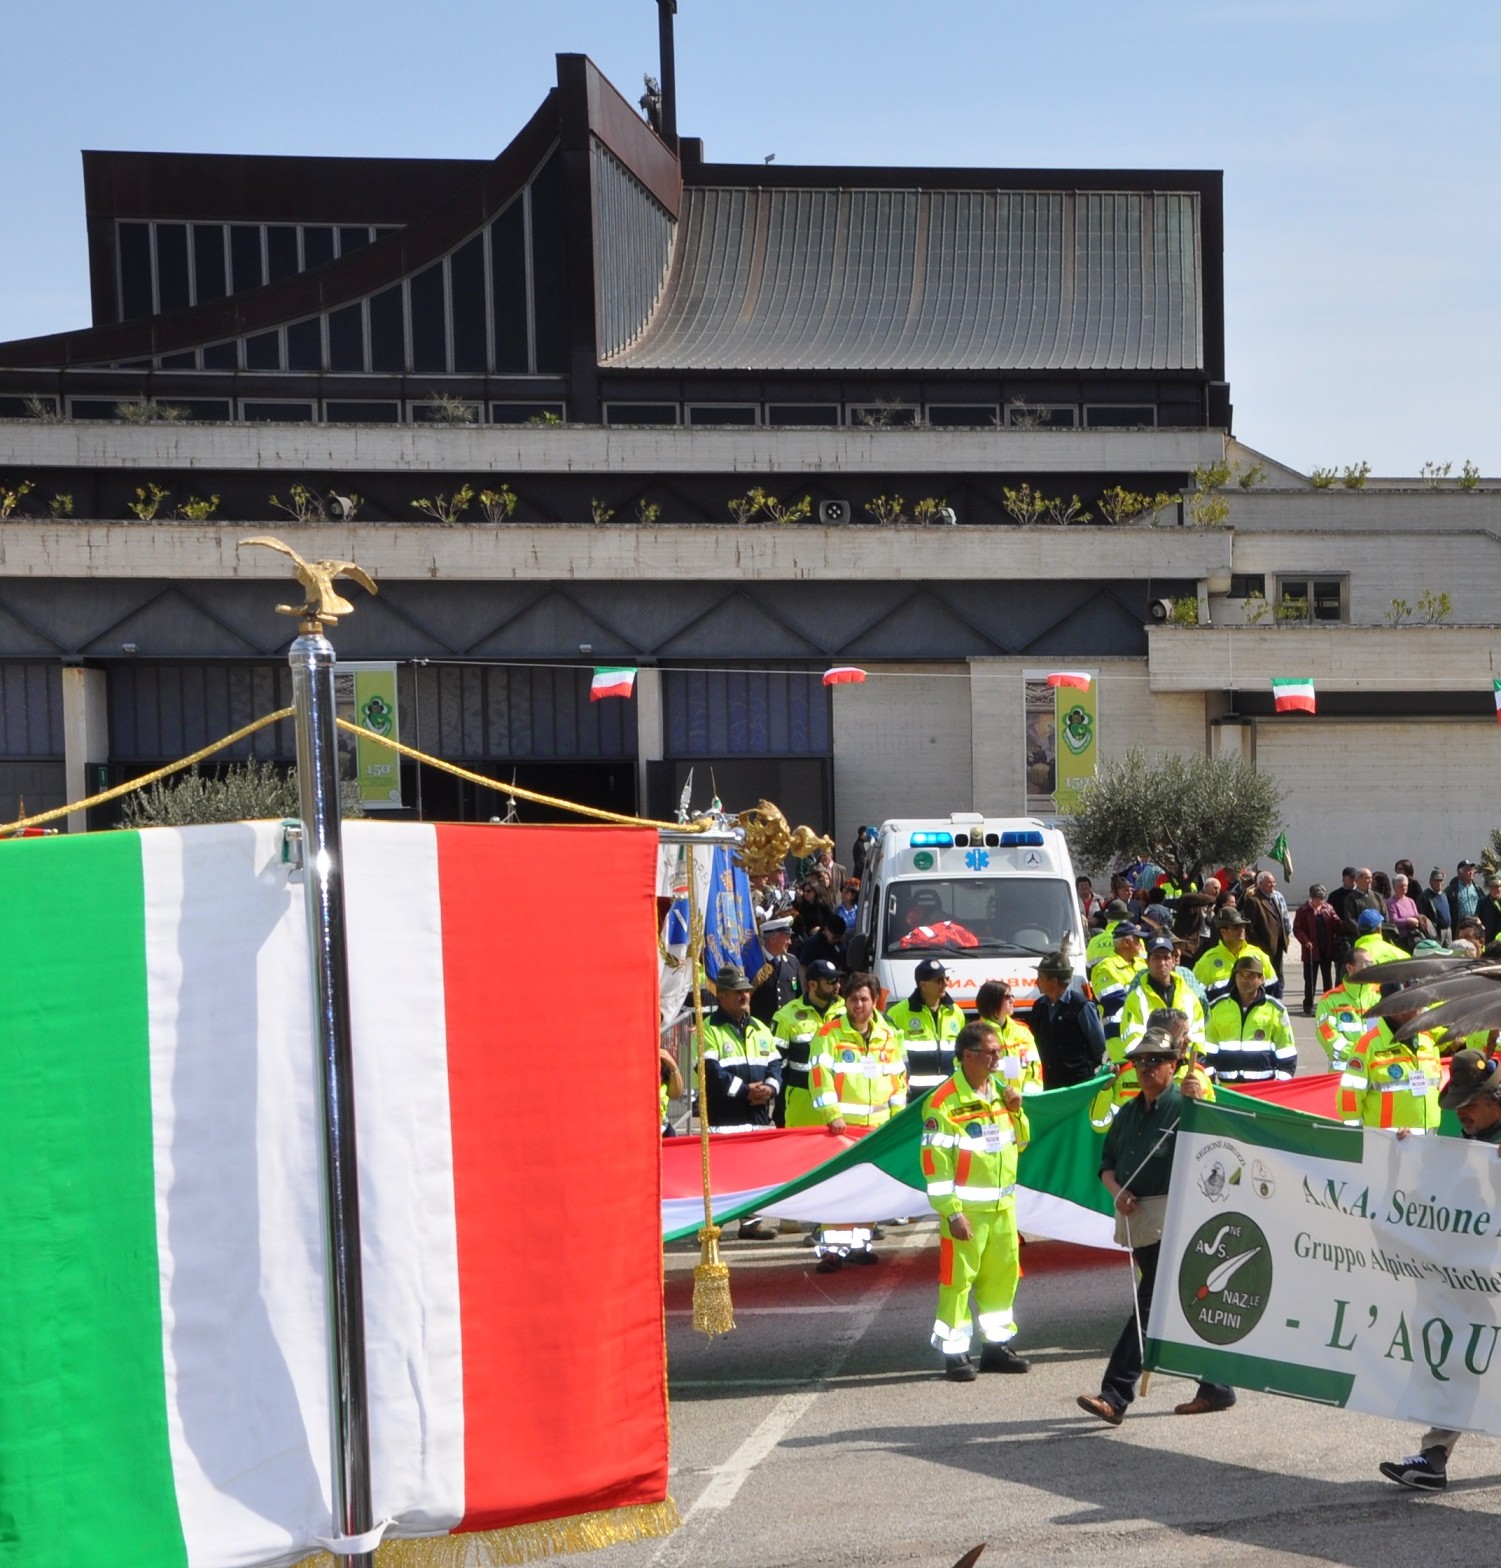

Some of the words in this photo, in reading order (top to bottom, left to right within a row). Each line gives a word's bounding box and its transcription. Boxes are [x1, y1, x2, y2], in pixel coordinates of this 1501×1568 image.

[1302, 1174, 1377, 1221] A.N.A.
[1386, 1189, 1491, 1236] Sezione
[1294, 1231, 1366, 1273] Gruppo
[1371, 1247, 1426, 1281] Alpini
[1198, 1307, 1241, 1329] ALPINI
